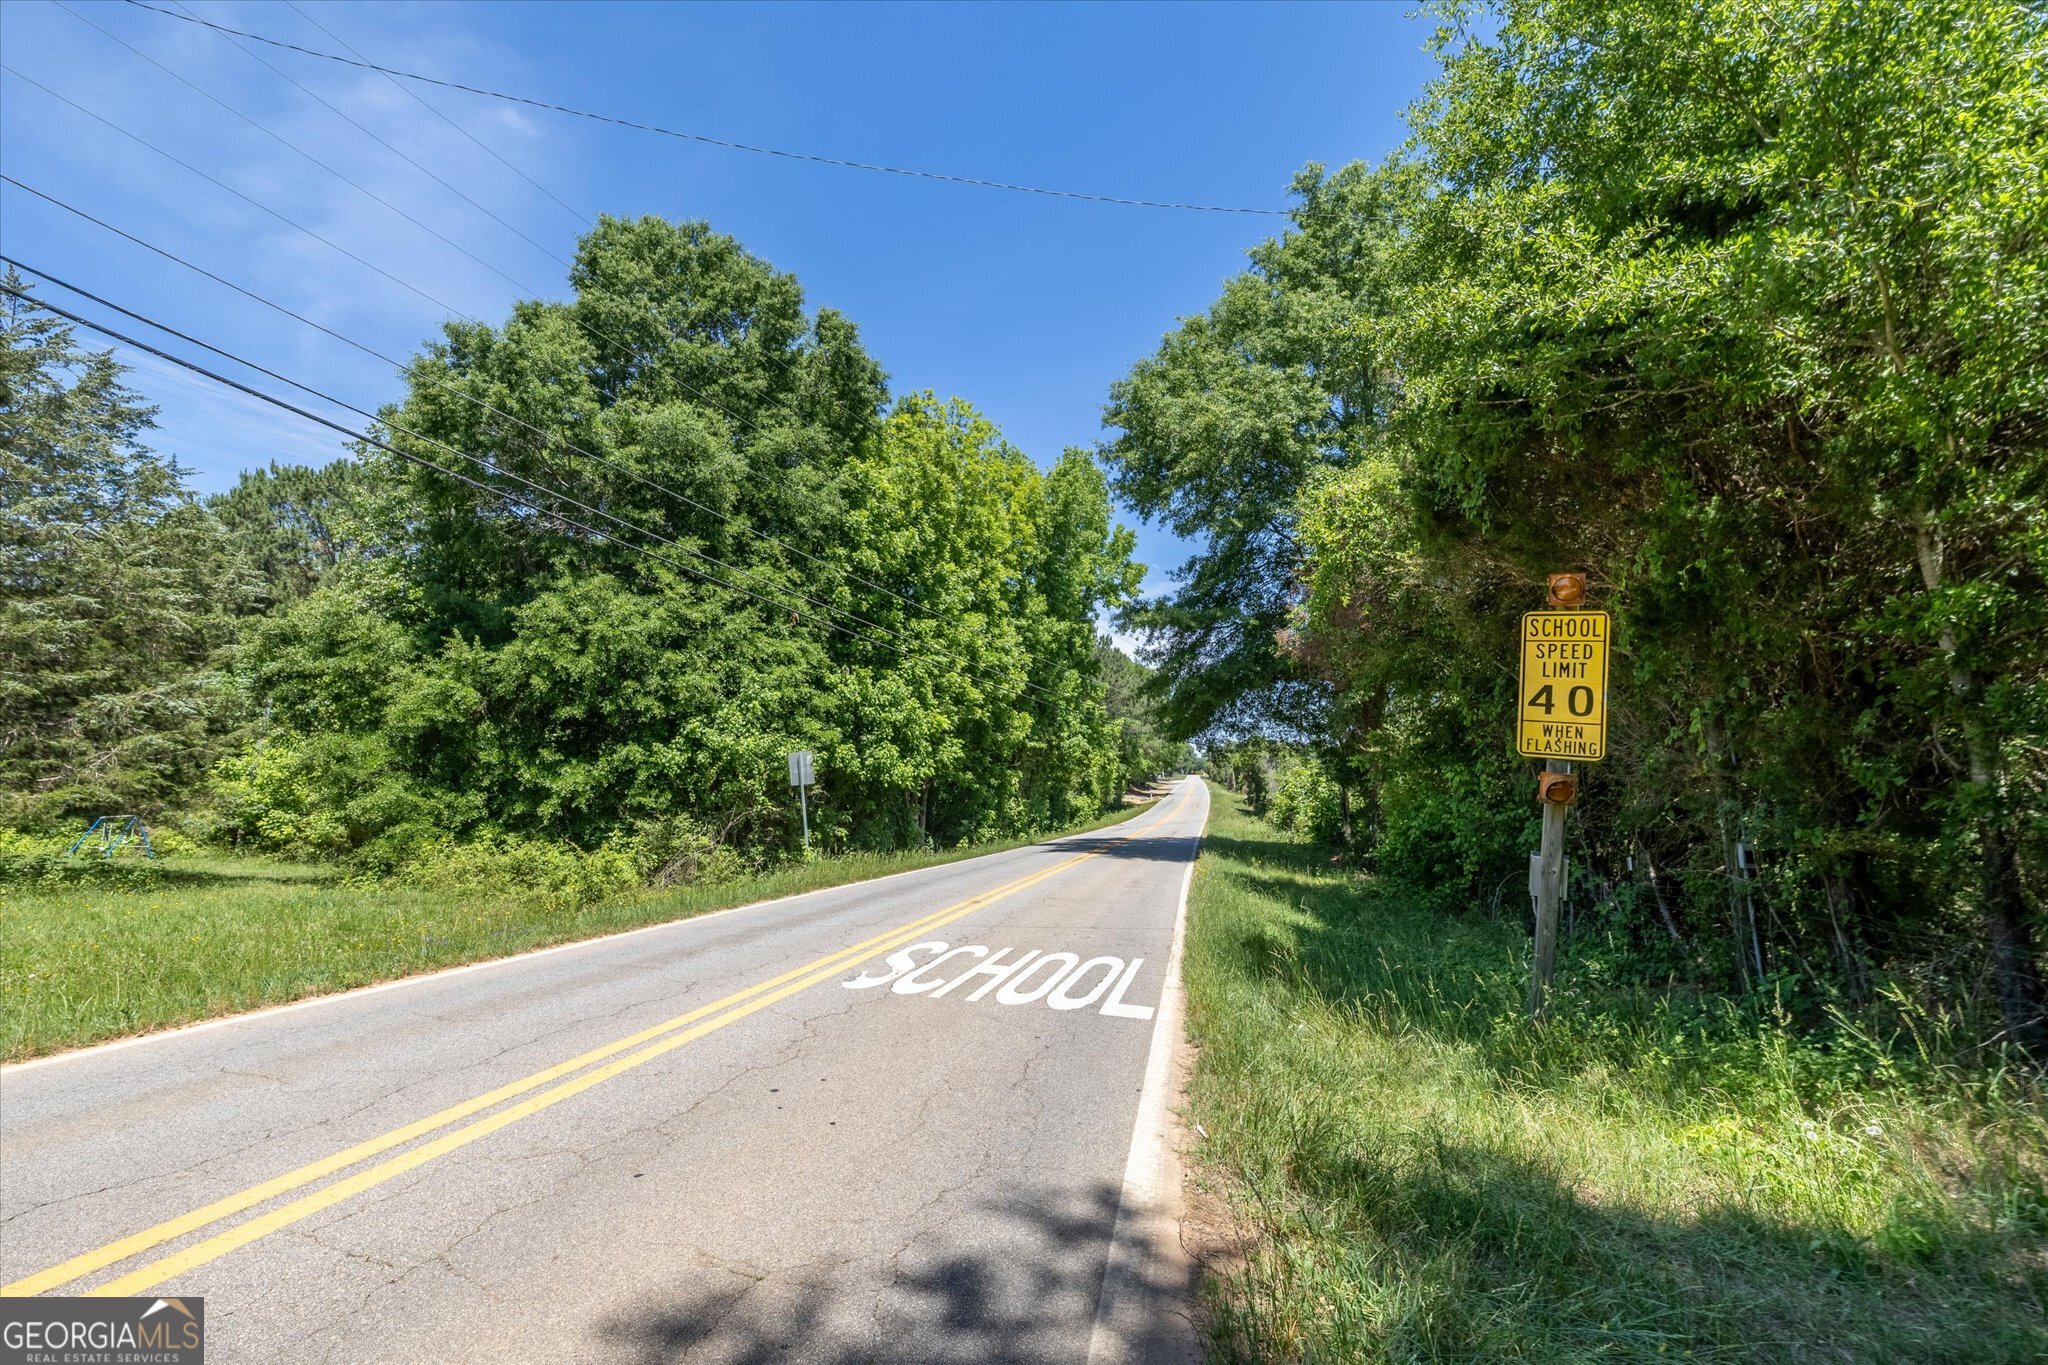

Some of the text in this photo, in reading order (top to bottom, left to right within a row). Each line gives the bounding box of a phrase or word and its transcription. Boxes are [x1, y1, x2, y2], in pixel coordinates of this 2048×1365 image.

[1529, 618, 1601, 638] SCHOOL
[1536, 643, 1593, 660] SPEED
[1542, 662, 1588, 679] LIMIT
[1527, 684, 1594, 717] 40
[1542, 724, 1584, 740] WHEN
[1527, 738, 1597, 756] FLASHING
[842, 941, 1156, 1020] SCHOOL
